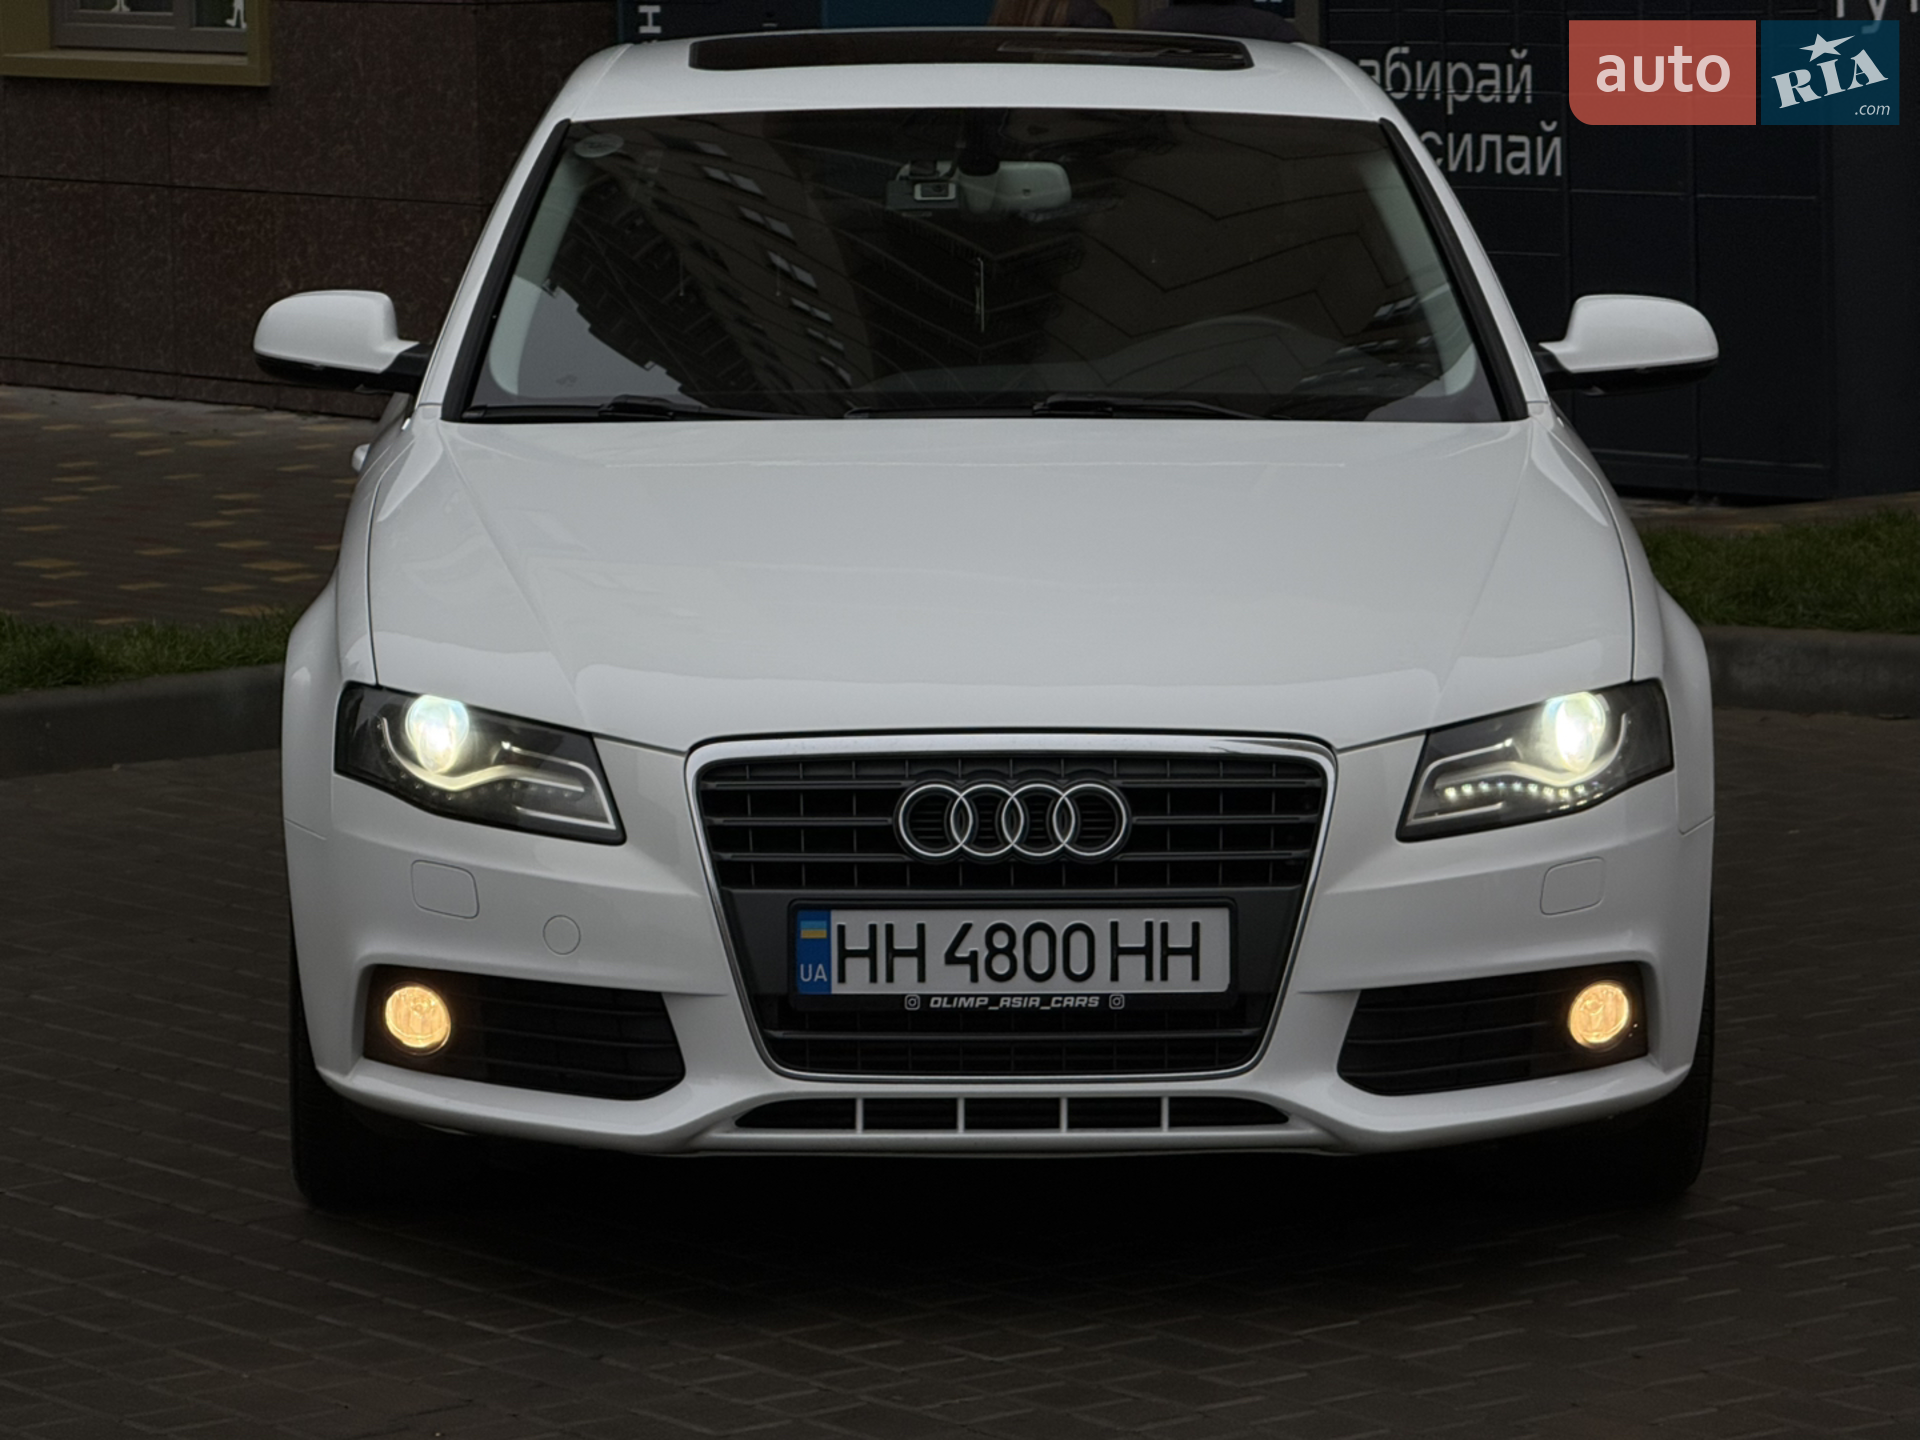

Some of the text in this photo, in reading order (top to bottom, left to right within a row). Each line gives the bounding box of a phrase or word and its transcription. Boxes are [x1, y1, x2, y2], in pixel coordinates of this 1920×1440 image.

[837, 920, 1201, 983] HH 4800 HH
[800, 963, 828, 982] UA
